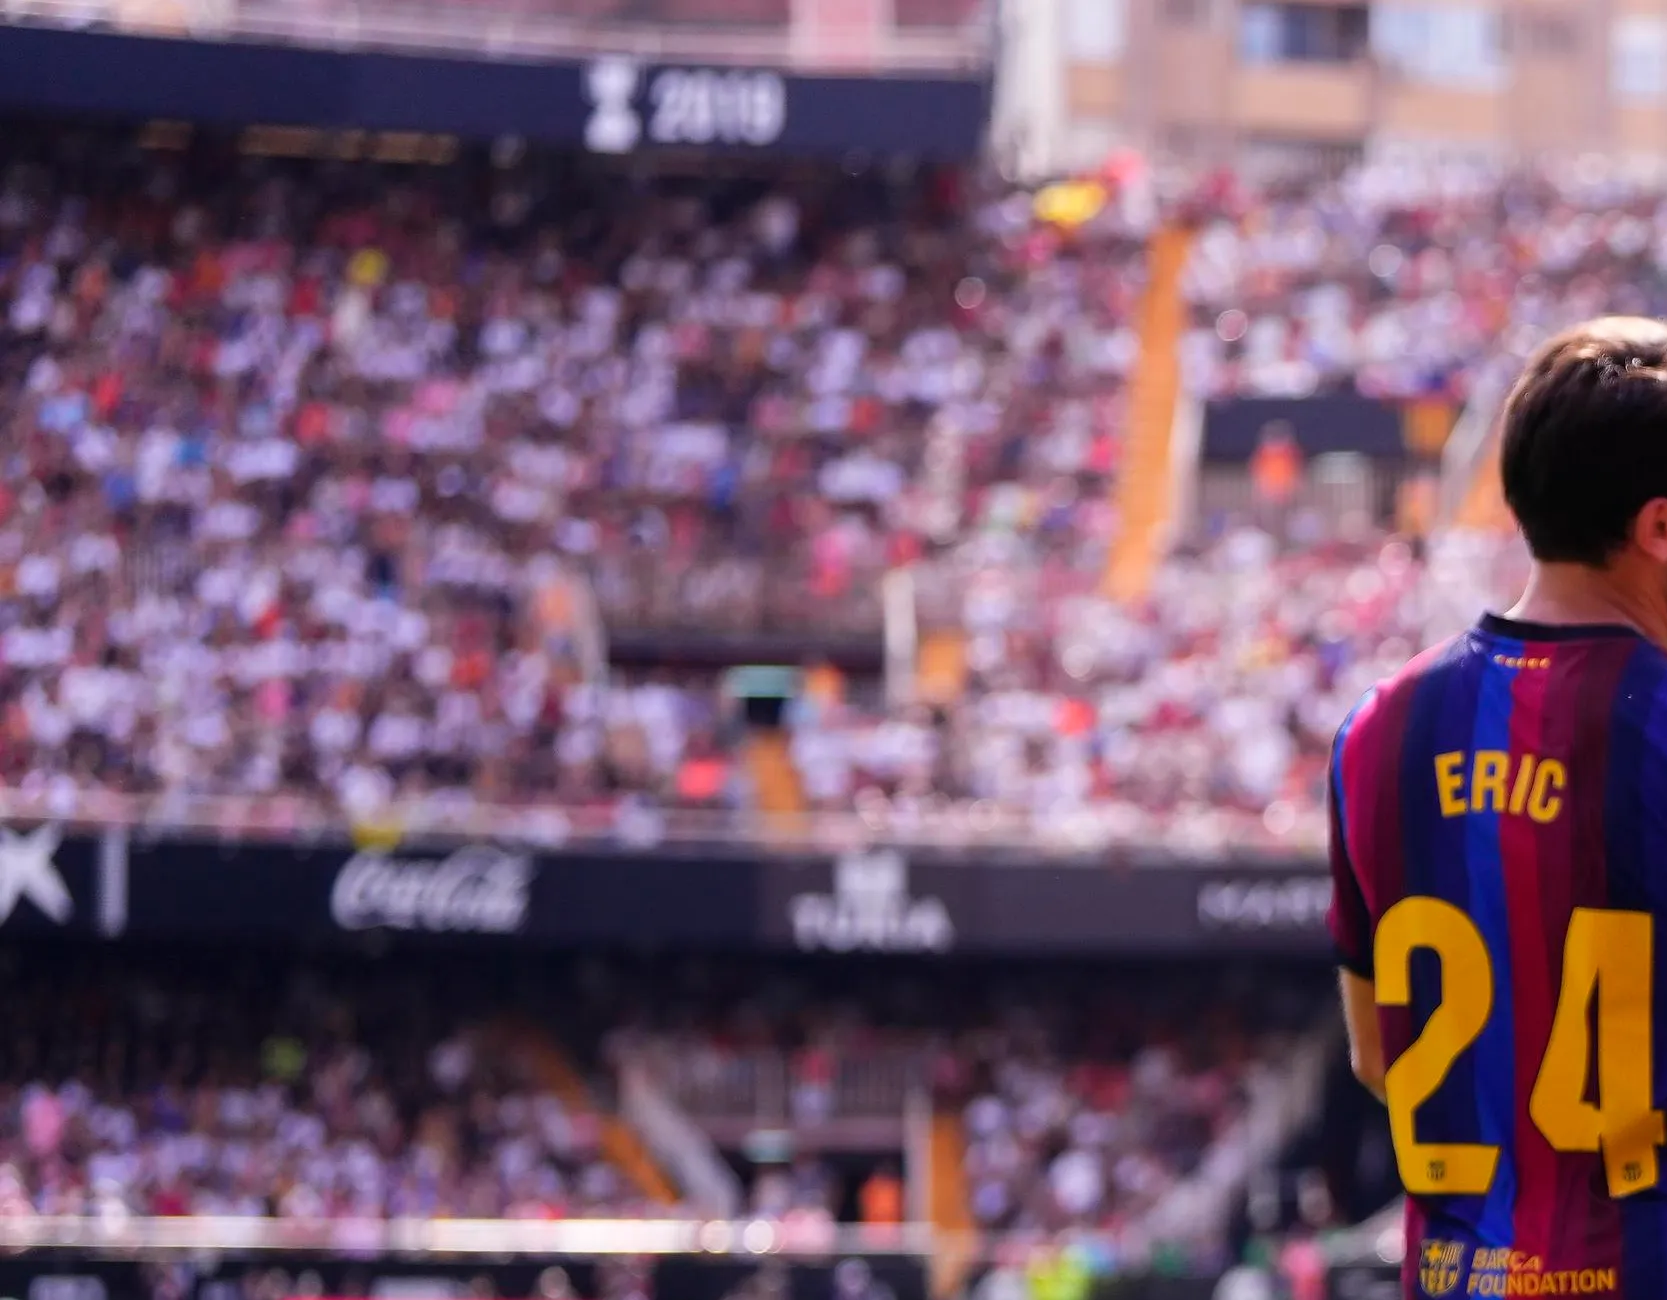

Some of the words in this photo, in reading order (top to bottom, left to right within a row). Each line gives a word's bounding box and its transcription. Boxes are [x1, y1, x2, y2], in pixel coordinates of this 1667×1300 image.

[1433, 749, 1567, 824] ERIC
[1373, 895, 1665, 1198] 24
[1466, 1267, 1616, 1297] FOUNDATION
